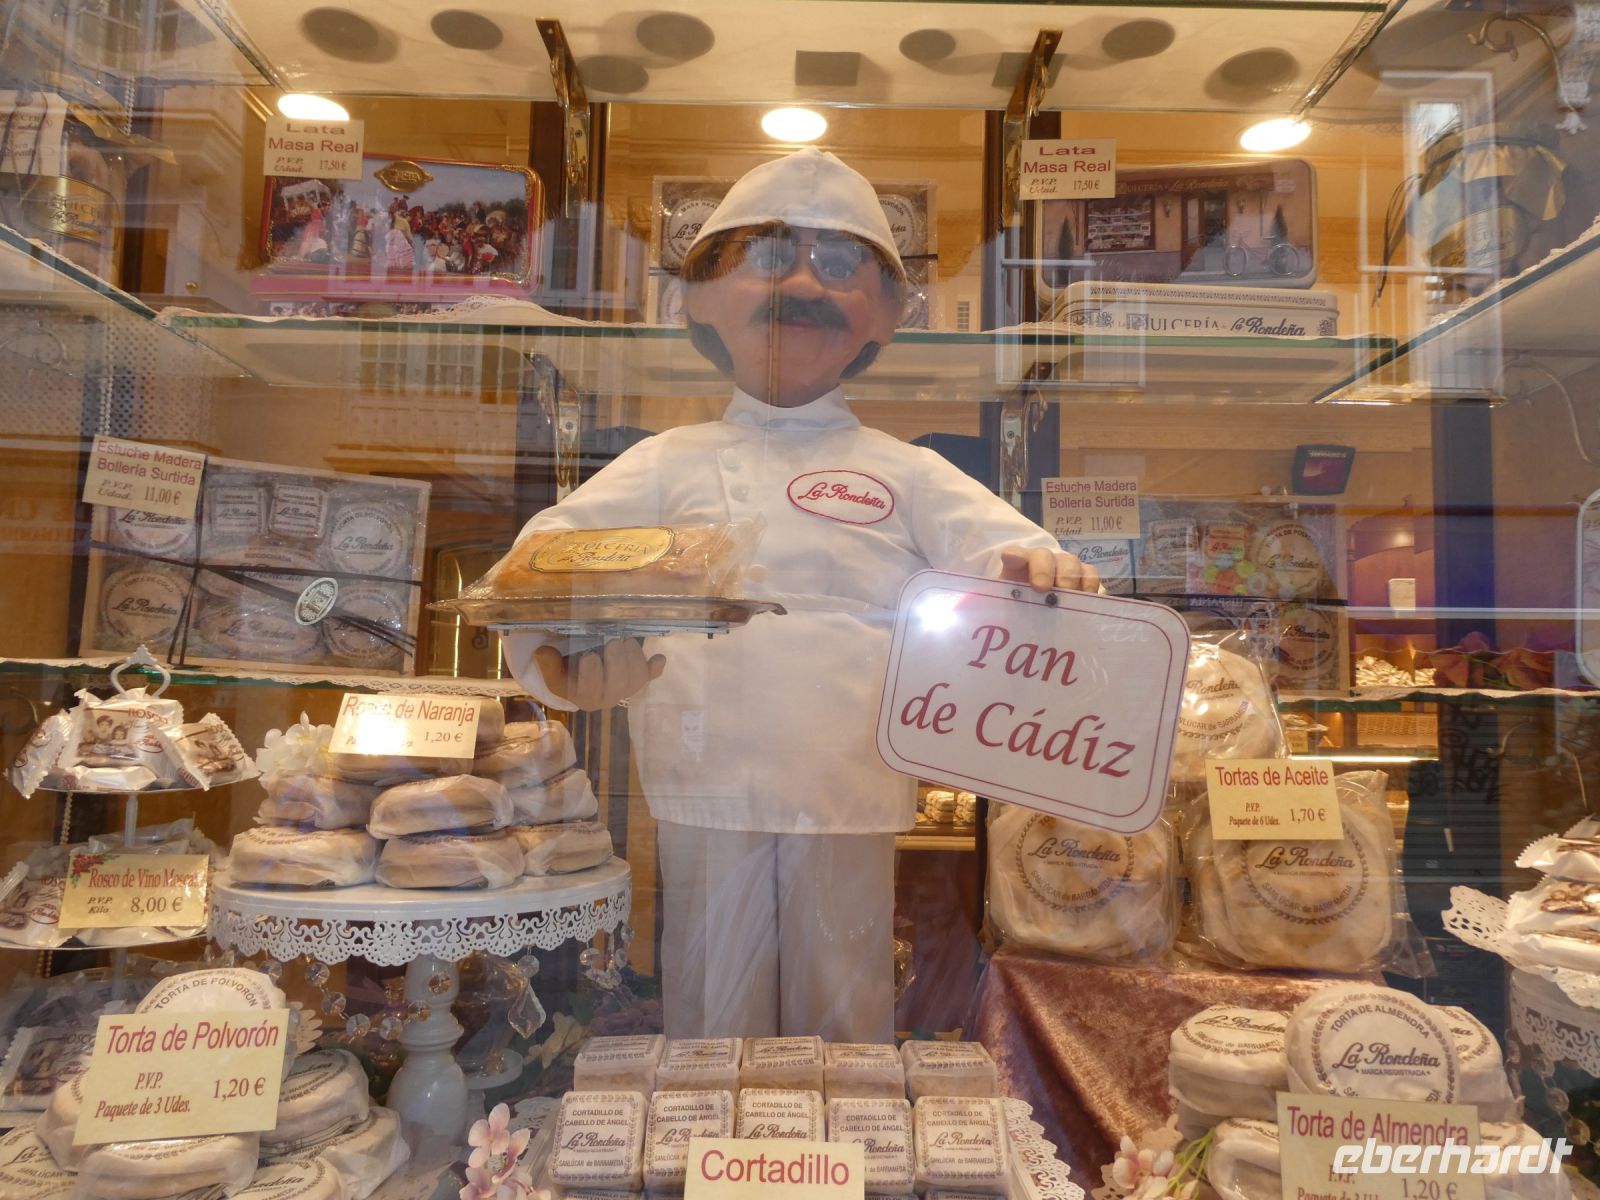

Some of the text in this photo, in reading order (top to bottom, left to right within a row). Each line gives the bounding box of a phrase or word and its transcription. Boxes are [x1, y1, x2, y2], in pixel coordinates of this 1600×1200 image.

[286, 123, 345, 135] Lata
[268, 137, 359, 153] Masa Real
[1039, 146, 1096, 156] Lata
[1023, 159, 1111, 173] Masa Real
[1231, 316, 1306, 336] La Rondeña
[97, 439, 201, 470] Estuche Madera
[97, 457, 196, 487] Bollería Surtida
[144, 485, 182, 505] 11,00 €
[797, 481, 886, 510] La Rondeña
[1046, 480, 1137, 493] Estuche Madera
[1049, 495, 1135, 509] Bollería Surtida
[1055, 516, 1082, 525] P.V.P.
[1091, 516, 1123, 532] 11,00 €
[967, 624, 1079, 687] Pan
[395, 699, 475, 727] de Naranja
[899, 682, 958, 735] de
[423, 731, 451, 743] 1,20
[453, 731, 464, 743] €
[1215, 765, 1329, 786] Tortas de Aceite
[1245, 802, 1261, 813] P.V.P.
[1289, 808, 1327, 823] 1,70 €
[1228, 816, 1251, 828] Paquete
[1251, 815, 1260, 826] de
[1260, 815, 1265, 826] 6
[1027, 837, 1121, 862] La Rondeña
[1254, 846, 1356, 870] La Rondeña
[88, 867, 160, 888] Rosco de Vino
[87, 896, 113, 905] P.V.P.
[88, 905, 109, 914] Kilo
[130, 896, 183, 915] 8,00 €
[154, 977, 259, 1011] TORTA DE POLVORÓN
[1194, 1014, 1229, 1025] La
[1330, 1009, 1359, 1033] TORTA
[1358, 1004, 1373, 1014] DE
[1374, 1004, 1430, 1039] ALMENDRA
[107, 1019, 279, 1054] Torta de Polvorón
[1331, 1041, 1441, 1070] La Rondeña
[134, 1071, 163, 1091] P.V.P.
[211, 1078, 249, 1102] 1,20
[253, 1076, 266, 1097] €
[94, 1096, 191, 1123] Paquete de 3 Udes.
[663, 1104, 704, 1112] CORTADILLO
[564, 1119, 595, 1127] CABELLO
[656, 1115, 688, 1123] CABELLO
[846, 1114, 887, 1122] CORTADILLO
[1287, 1105, 1469, 1148] Torta de Almendra
[656, 1128, 677, 1146] La
[744, 1123, 808, 1140] La Rondeña
[839, 1124, 871, 1132] CABELLO
[872, 1124, 881, 1132] DE
[561, 1132, 626, 1150] La Rondeña
[929, 1131, 993, 1148] La Rondeña
[700, 1149, 850, 1186] Cortadillo
[1401, 1177, 1459, 1200] 1,20 €
